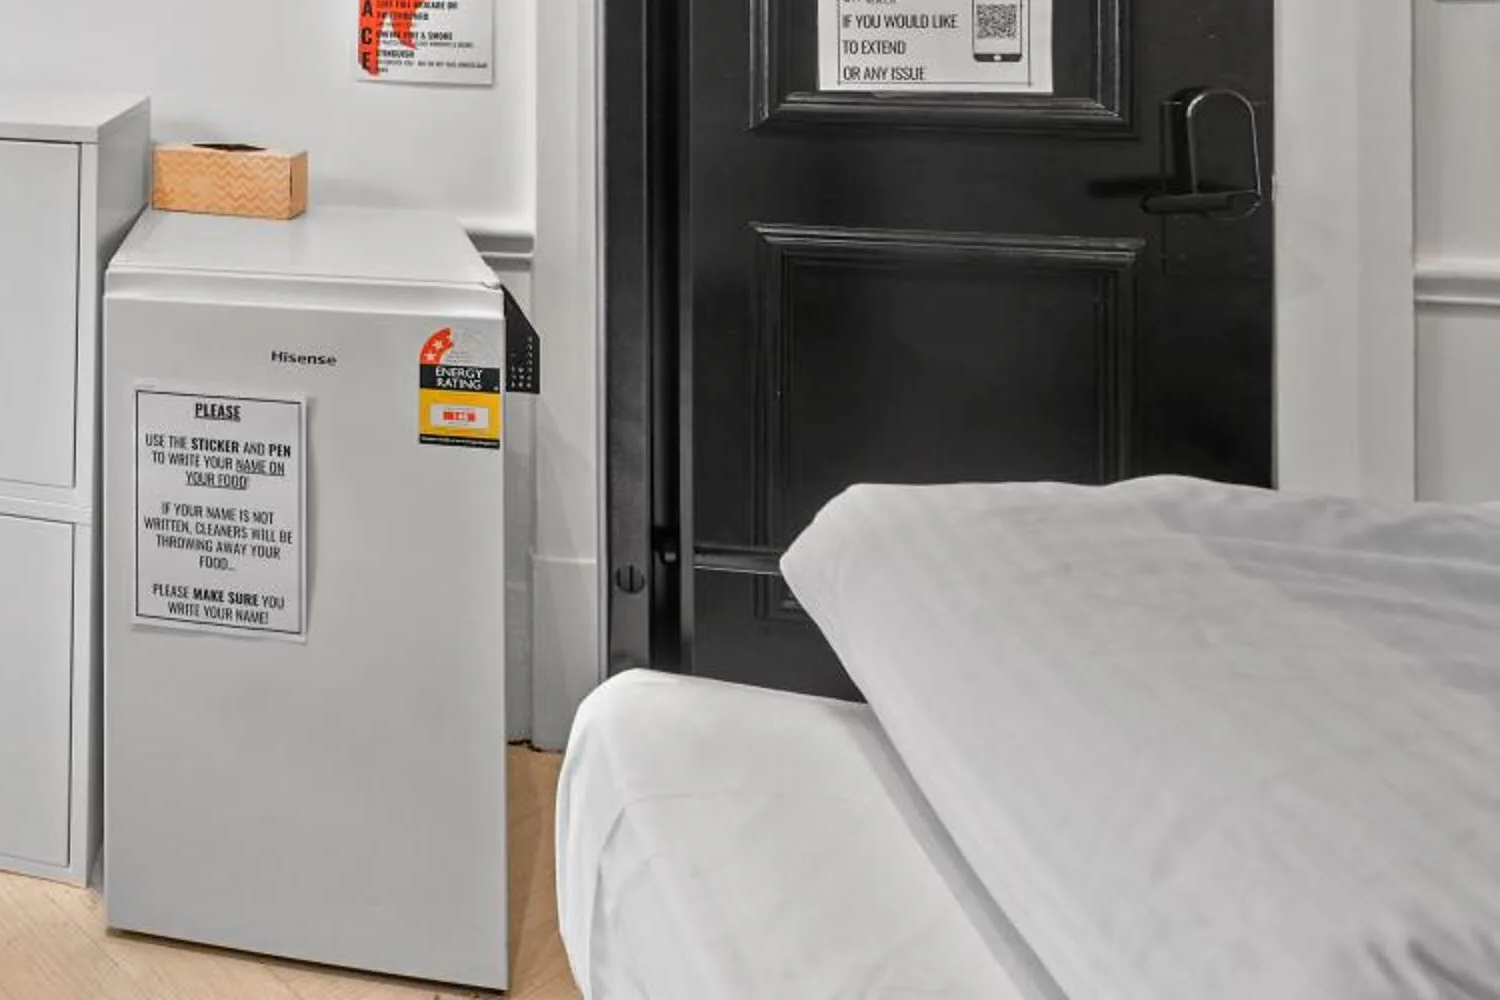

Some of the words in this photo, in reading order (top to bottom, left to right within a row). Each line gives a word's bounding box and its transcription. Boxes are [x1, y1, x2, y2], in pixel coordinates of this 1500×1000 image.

[362, 0, 374, 17] A
[843, 14, 852, 29] IF
[855, 14, 881, 29] YOU
[884, 14, 929, 29] WOULD
[931, 13, 959, 29] LIKE
[361, 27, 373, 45] C
[842, 39, 858, 55] TO
[861, 39, 907, 55] EXTEND
[362, 51, 372, 71] E
[843, 66, 861, 81] OR
[863, 66, 889, 81] ANY
[891, 66, 926, 81] ISSUE
[271, 351, 337, 367] Hisense
[435, 367, 483, 379] ENERGY
[436, 377, 483, 391] RATING
[195, 403, 241, 421] PLEASE
[145, 433, 164, 447] USE
[168, 435, 187, 449] THE
[191, 437, 239, 453] STICKER
[243, 441, 265, 456] AND
[269, 443, 291, 457] PEN
[152, 451, 165, 465] TO
[168, 453, 200, 468] WRITE
[203, 455, 233, 470] YOUR
[236, 458, 266, 474] NAME
[269, 461, 285, 477] ON
[185, 471, 215, 487] YOUR
[161, 501, 171, 515] IF
[174, 503, 203, 518] YOUR
[206, 506, 236, 521] NAME
[239, 509, 250, 523] IS
[253, 511, 275, 525] NOT
[143, 515, 192, 535] WRITTEN,
[195, 521, 249, 539] CLEANERS
[251, 528, 277, 543] WILL
[279, 530, 293, 545] BE
[156, 533, 213, 552] THROWING
[215, 540, 247, 556] AWAY
[250, 544, 281, 559] YOUR
[152, 583, 189, 599] PLEASE
[192, 588, 225, 602] MAKE
[228, 591, 259, 606] SURE
[262, 595, 285, 609] YOU
[167, 602, 200, 617] WRITE
[203, 605, 233, 620] YOUR
[235, 609, 269, 624] NAME!
